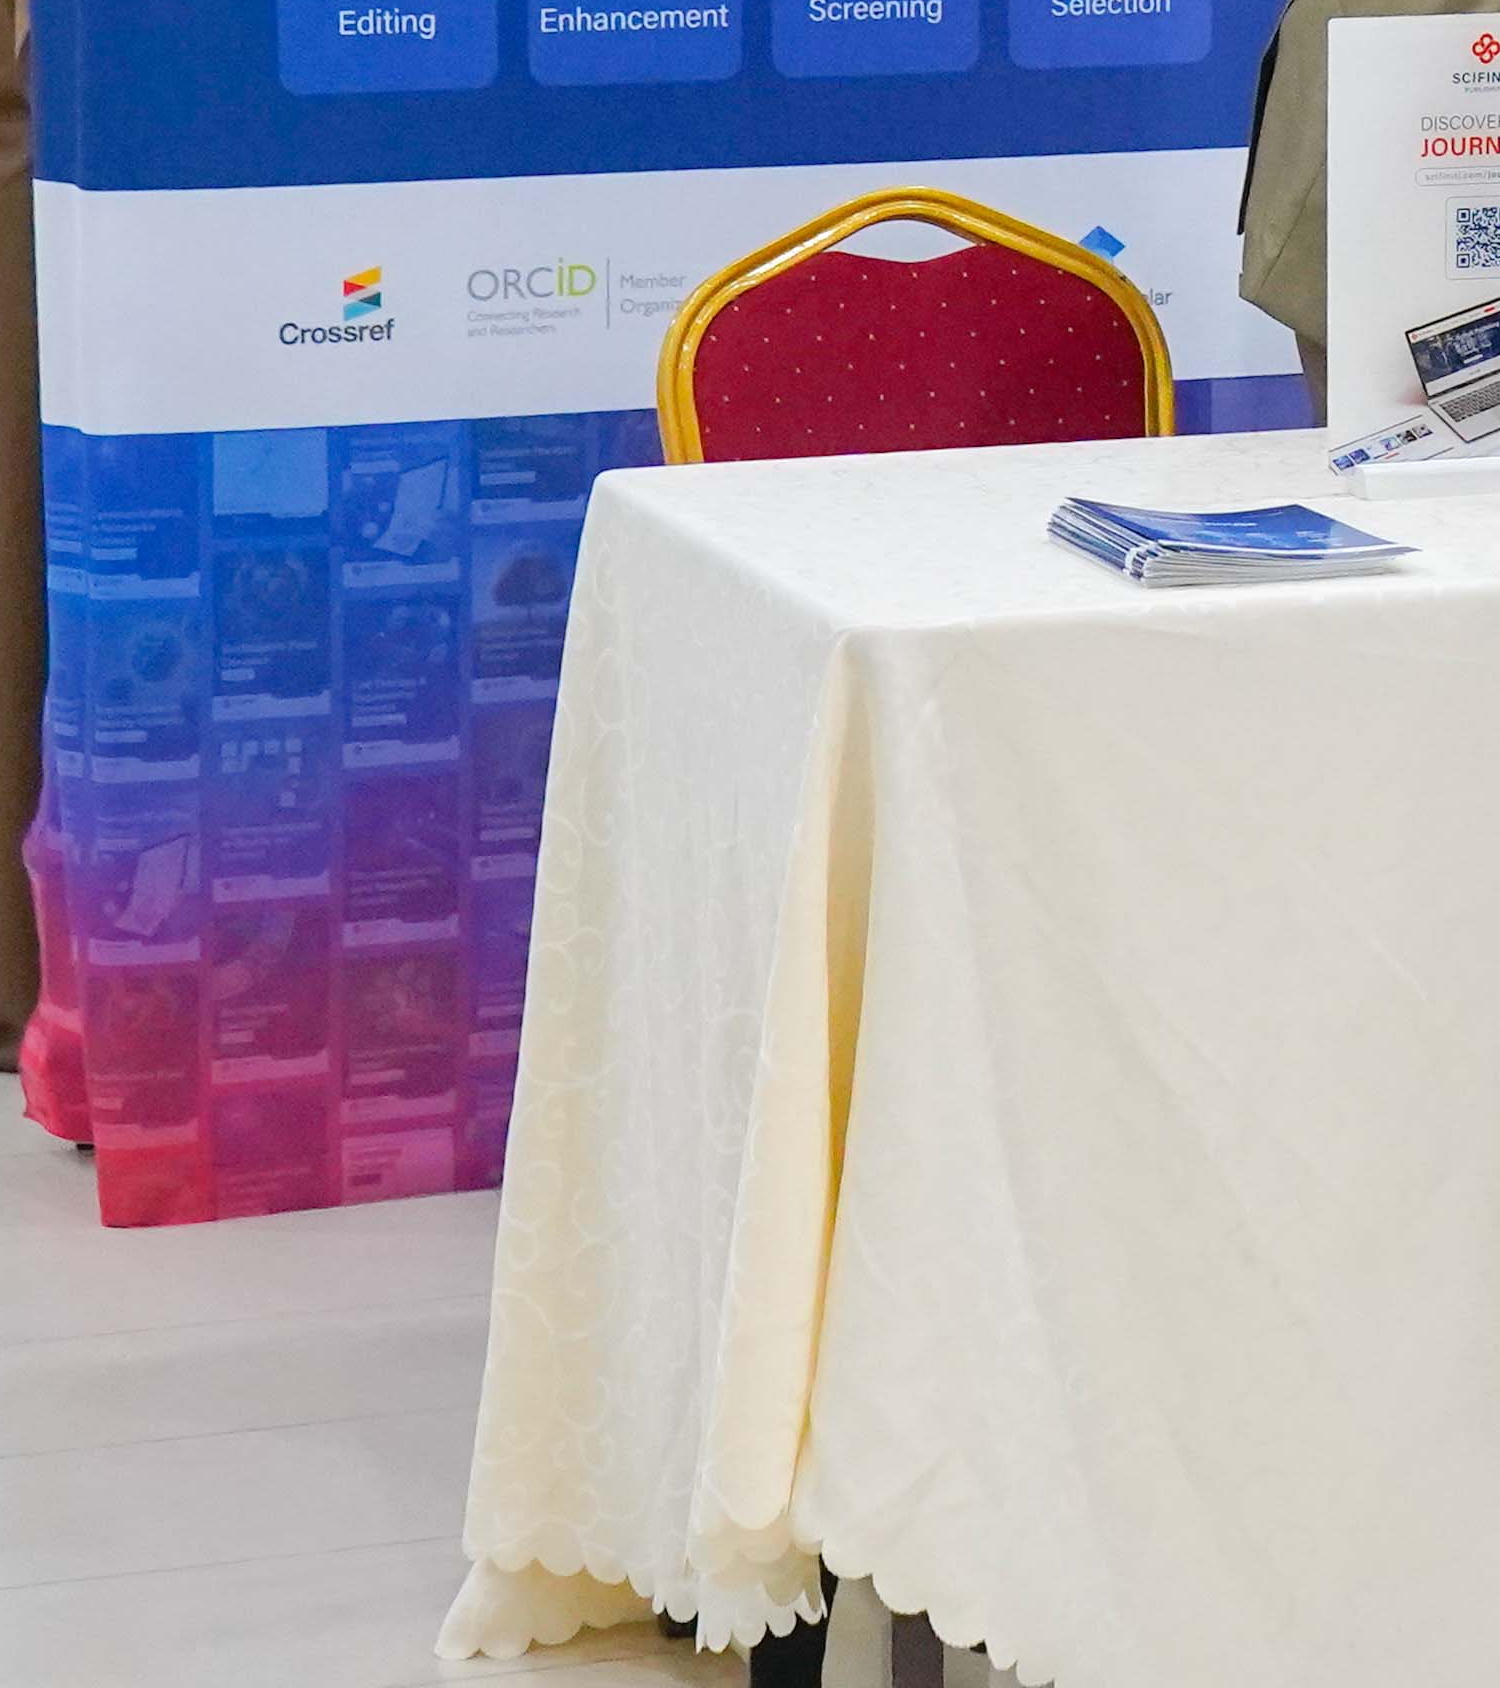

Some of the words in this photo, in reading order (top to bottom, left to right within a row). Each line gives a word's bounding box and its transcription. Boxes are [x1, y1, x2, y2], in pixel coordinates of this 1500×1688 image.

[337, 4, 437, 40] Editing
[540, 3, 730, 33] Enhancement
[620, 273, 686, 289] Member
[620, 298, 683, 317] Organi
[279, 319, 394, 345] Crossref
